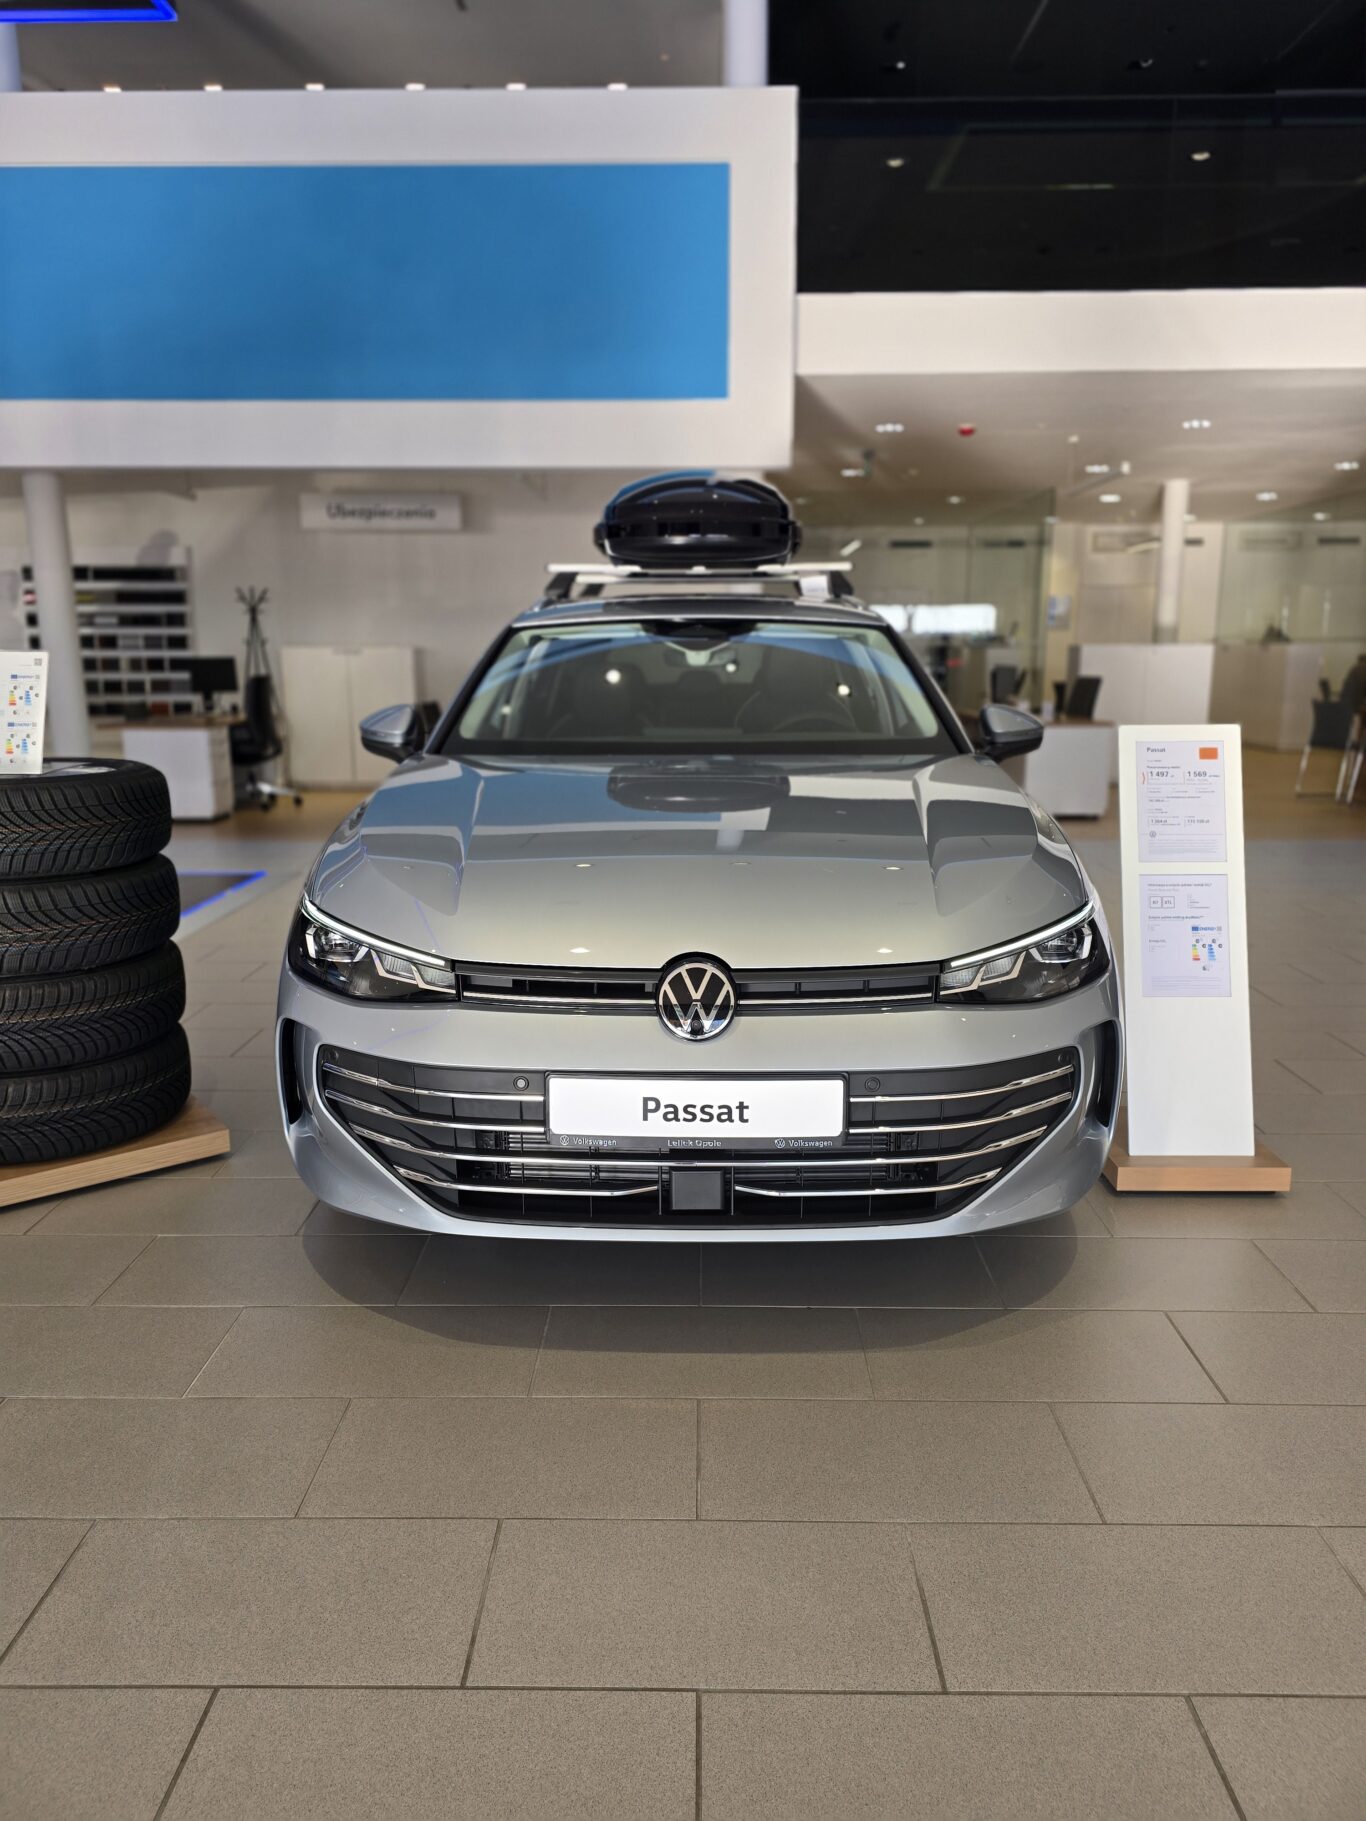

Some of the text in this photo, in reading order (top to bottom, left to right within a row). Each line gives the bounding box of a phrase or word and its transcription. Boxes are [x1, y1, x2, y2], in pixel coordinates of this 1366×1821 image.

[642, 1096, 749, 1123] Passat
[573, 1137, 617, 1147] Volkswagen
[788, 1139, 833, 1147] Volkswagen
